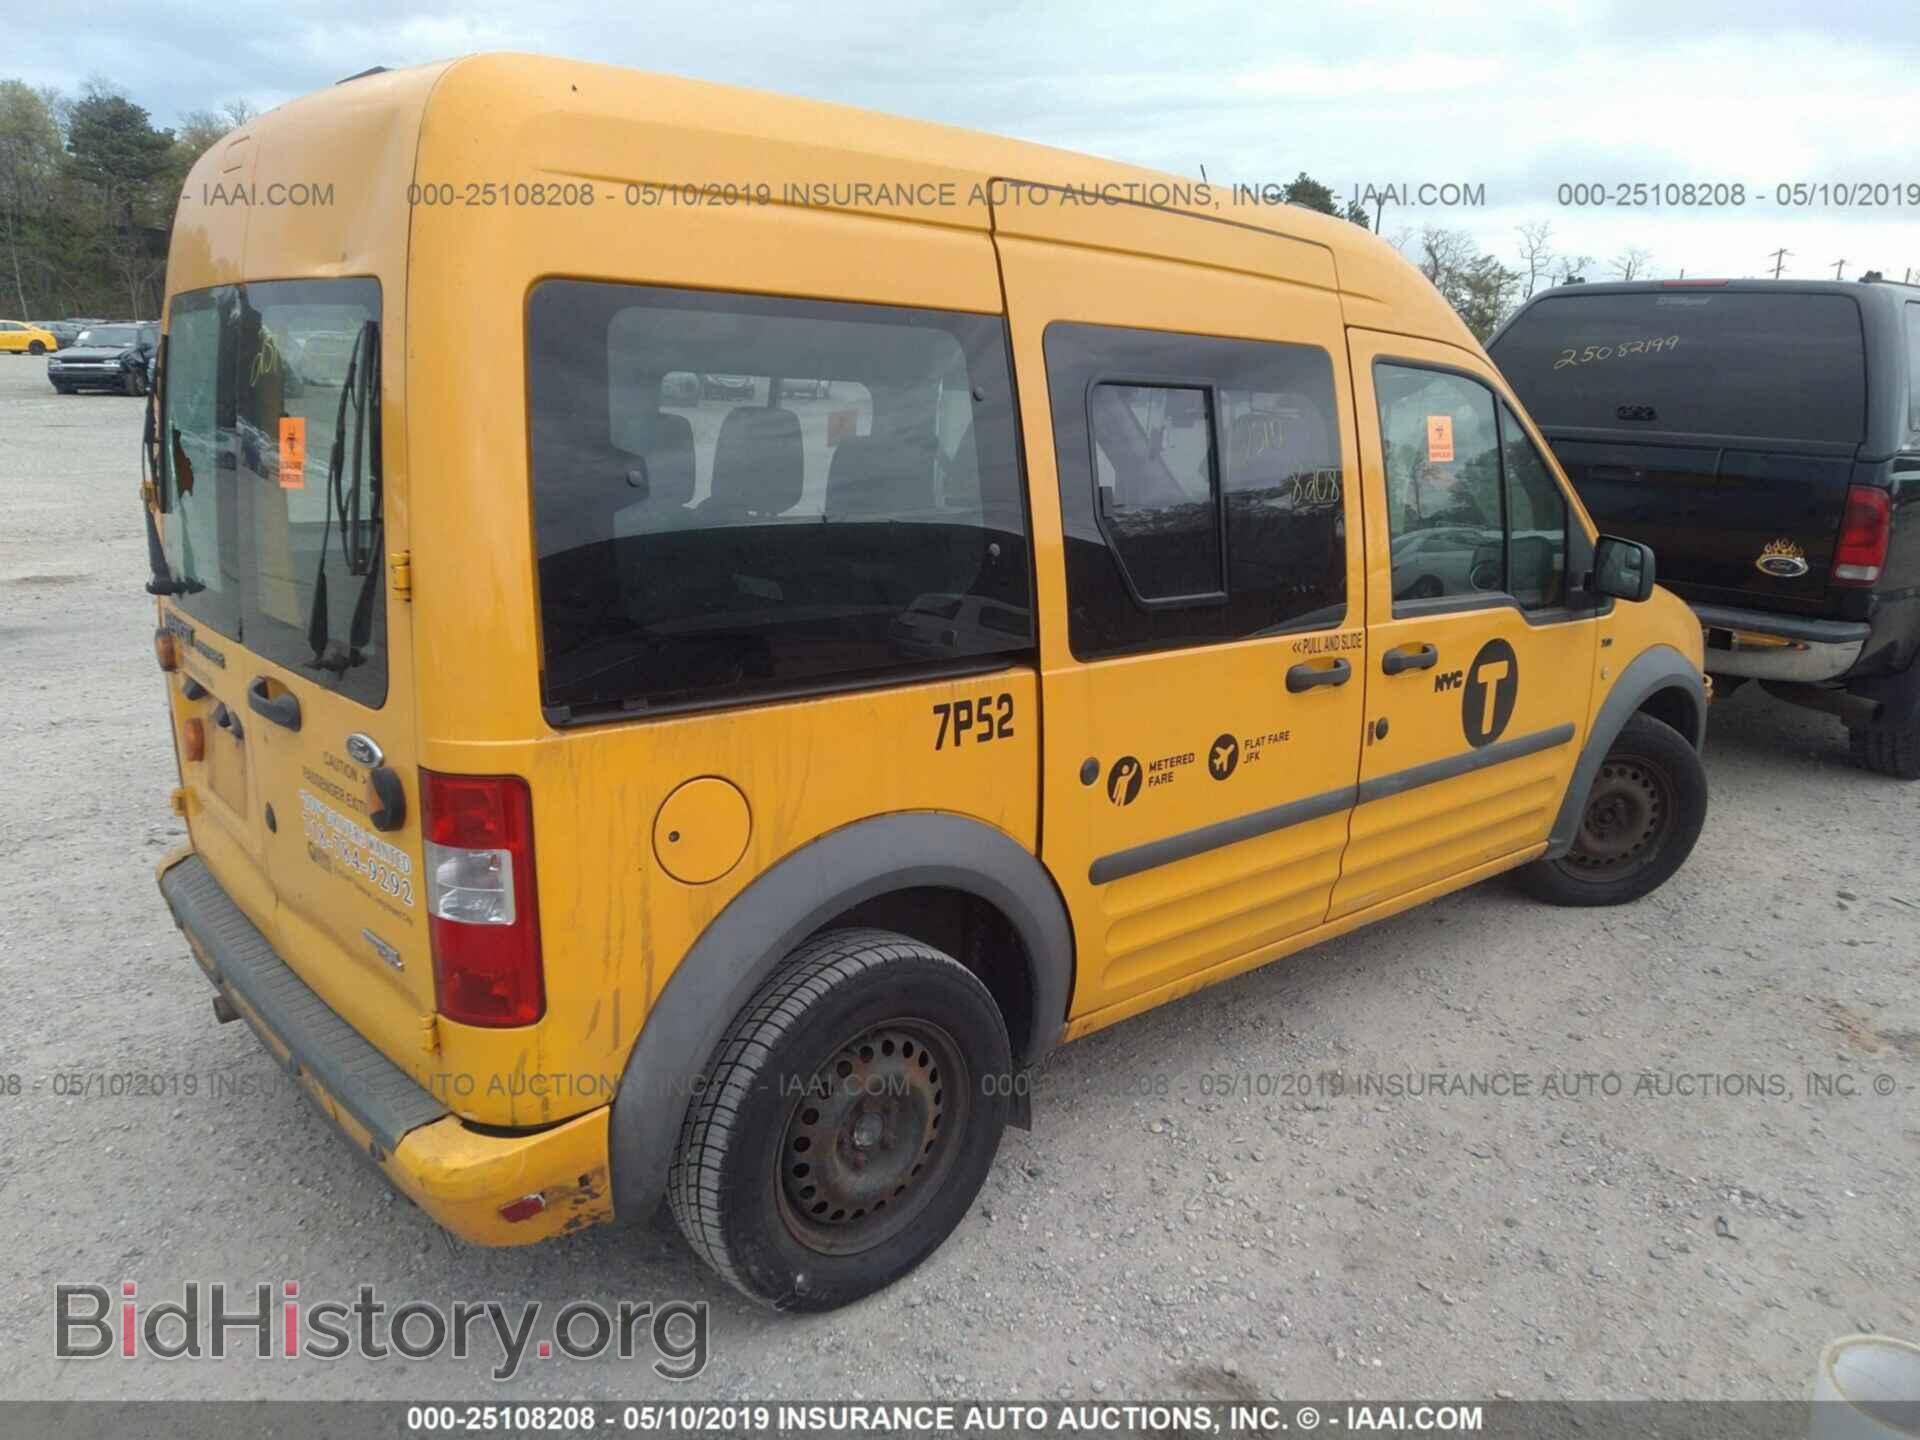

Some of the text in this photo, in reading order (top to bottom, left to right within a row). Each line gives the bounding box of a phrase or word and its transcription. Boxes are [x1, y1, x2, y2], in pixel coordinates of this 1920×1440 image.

[1302, 637, 1323, 654] PULL
[1341, 631, 1363, 650] SLIDE
[1434, 670, 1463, 693] NYC
[1476, 660, 1510, 736] T
[933, 692, 1014, 752] 7P52
[1243, 730, 1292, 750] FLAT FARE
[1148, 752, 1196, 773] METERED
[1243, 750, 1261, 765] JFK
[1147, 771, 1175, 789] FARE
